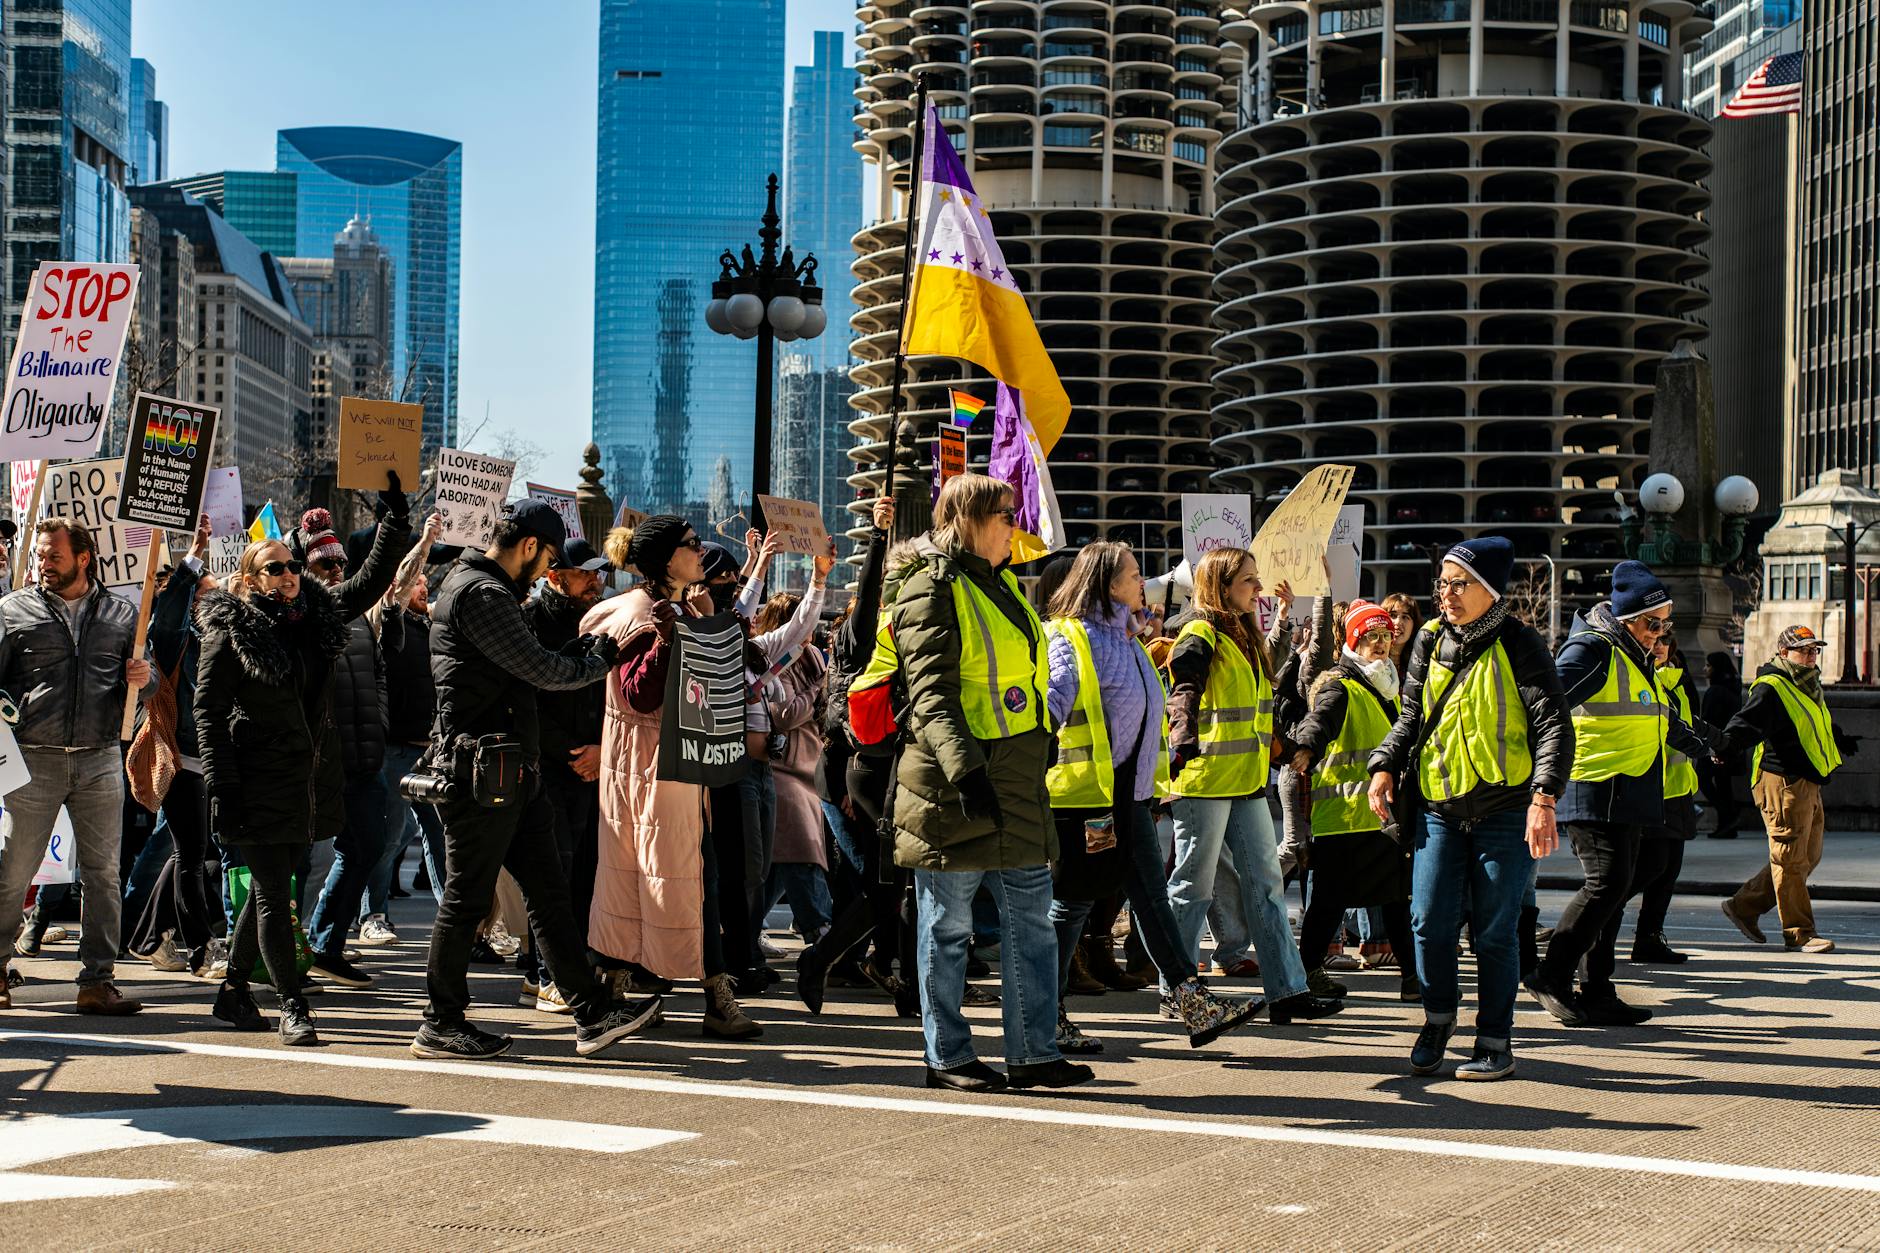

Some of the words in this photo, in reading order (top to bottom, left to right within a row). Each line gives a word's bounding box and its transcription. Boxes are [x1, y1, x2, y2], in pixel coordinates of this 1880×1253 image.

[36, 267, 131, 322] STOP
[50, 326, 93, 353] The
[5, 387, 104, 443] Oligarchy
[349, 411, 372, 425] WE
[143, 402, 203, 459] NO!
[142, 452, 151, 463] In
[152, 455, 166, 466] the
[167, 457, 191, 470] Name
[441, 453, 445, 465] I
[448, 454, 479, 471] LOVE
[479, 461, 514, 478] SOMEONE
[53, 468, 105, 500] PRO
[138, 476, 152, 488] We
[153, 479, 189, 494] REFUSE
[140, 465, 150, 474] of
[150, 465, 190, 484] Humanity
[440, 470, 470, 487] WHO
[471, 477, 490, 491] HAD
[490, 481, 503, 493] AN
[127, 496, 156, 510] Fascist
[157, 501, 191, 516] America
[138, 487, 147, 497] to
[148, 489, 177, 504] Accept
[178, 496, 183, 504] a
[437, 489, 488, 508] ABORTION
[1186, 504, 1218, 533] WELL
[681, 737, 699, 762] IN
